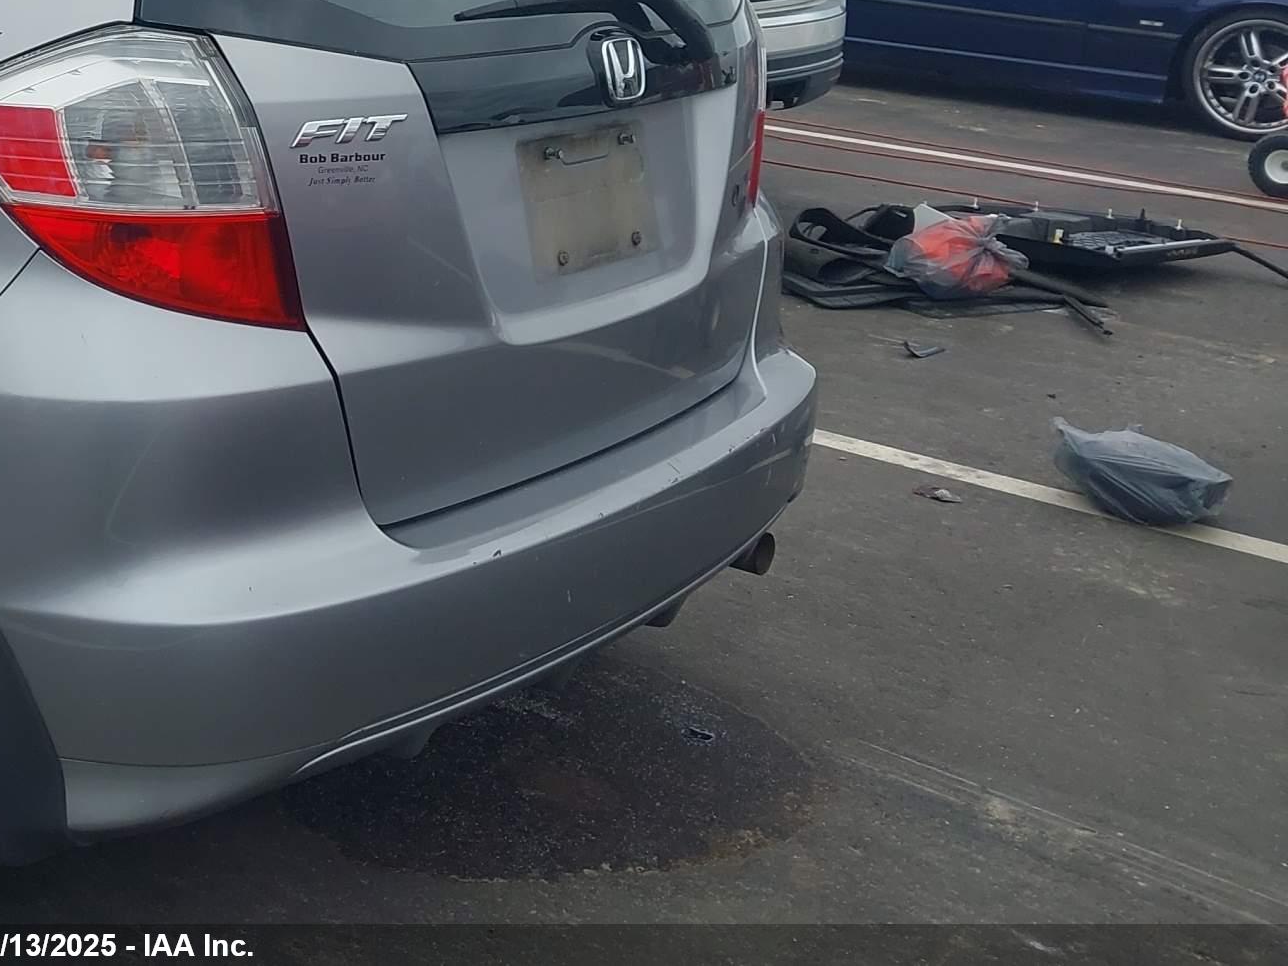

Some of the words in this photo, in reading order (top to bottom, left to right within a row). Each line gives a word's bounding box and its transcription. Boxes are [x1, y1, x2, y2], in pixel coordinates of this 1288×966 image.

[289, 114, 408, 148] FIT
[299, 153, 326, 164] Bob
[331, 152, 386, 163] Barbour
[357, 165, 369, 173] NC
[308, 177, 324, 186] Just
[326, 177, 350, 186] Simply
